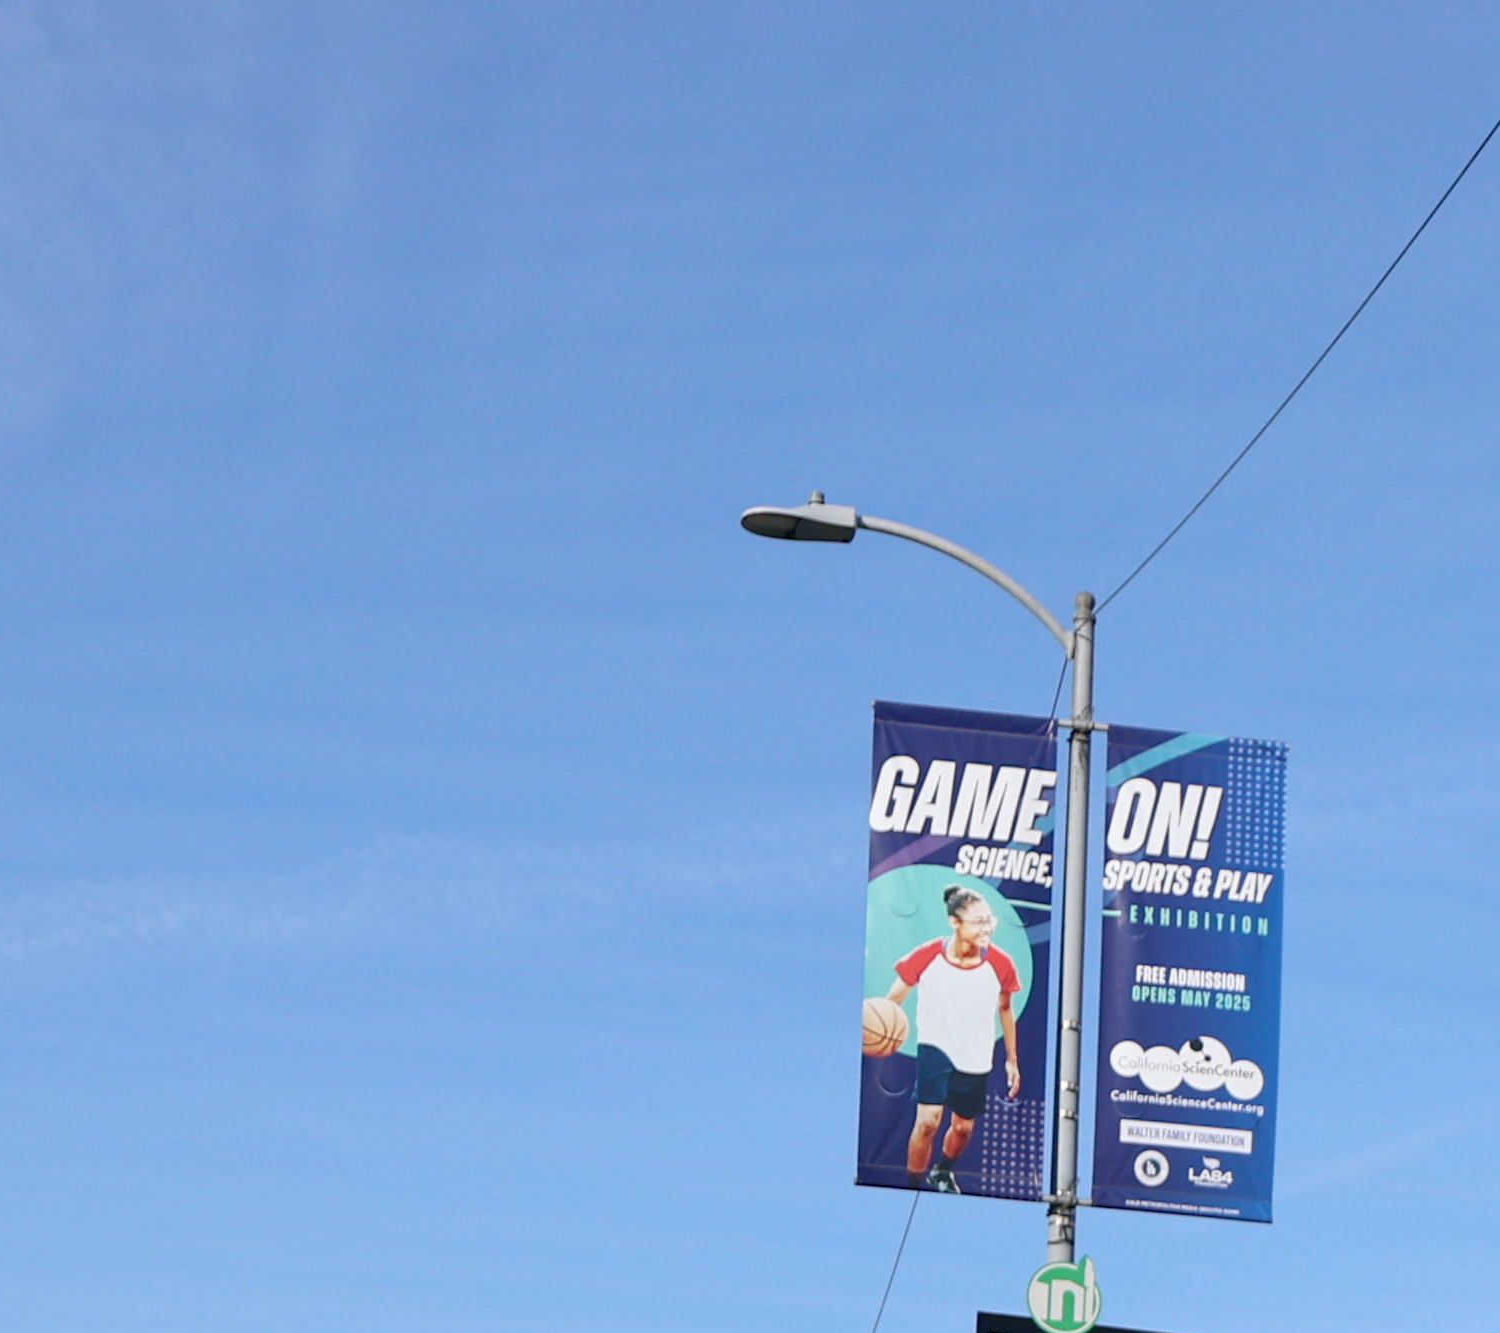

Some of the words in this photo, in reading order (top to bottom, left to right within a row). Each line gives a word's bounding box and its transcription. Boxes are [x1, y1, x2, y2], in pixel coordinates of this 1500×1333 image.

[868, 755, 1057, 845] GAME
[1106, 777, 1224, 861] ON!
[955, 843, 1053, 889] SCIENCE,
[1102, 859, 1187, 899] SPORTS
[1193, 866, 1211, 897] &
[1214, 869, 1272, 903] PLAY
[1129, 903, 1269, 936] EXHIBITION
[1136, 965, 1166, 984] FREE
[1169, 967, 1246, 992] ADMISSION
[1132, 985, 1176, 1005] OPENS
[1180, 989, 1210, 1007] MAY
[1215, 992, 1251, 1011] 2025
[1118, 1055, 1181, 1073] California
[1110, 1090, 1265, 1117] CaliforniaScienceCenter.org
[1127, 1125, 1160, 1137] WALTER
[1162, 1128, 1192, 1141] FAMILY
[1194, 1131, 1245, 1147] FOUNDATION
[1188, 1167, 1233, 1184] LA84
